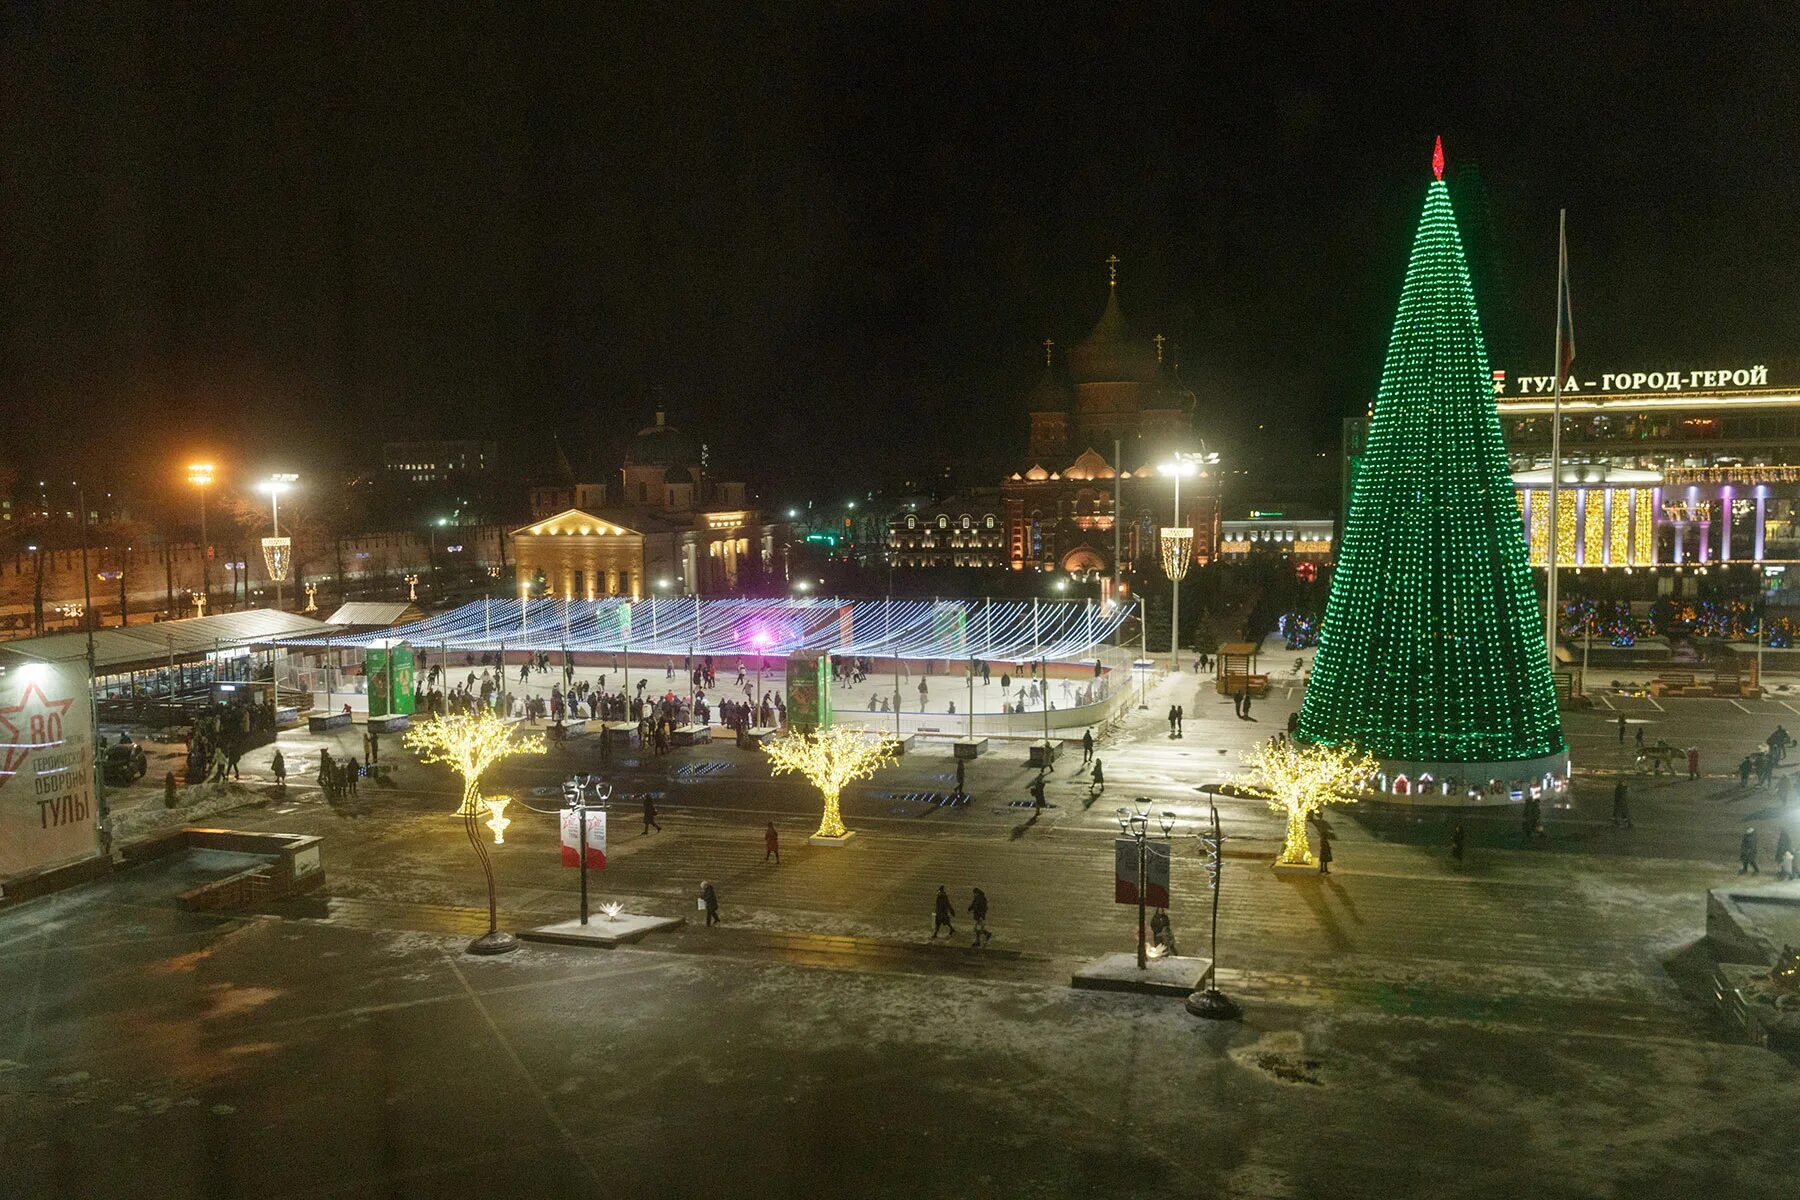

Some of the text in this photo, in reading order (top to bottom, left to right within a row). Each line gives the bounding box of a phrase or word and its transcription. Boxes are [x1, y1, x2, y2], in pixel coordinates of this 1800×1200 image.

[1518, 375, 1580, 393] ТУЛА
[1602, 365, 1768, 391] ГОРОД-ГЕРОЙ
[30, 712, 62, 751] 80
[35, 769, 87, 795] ОБОРОНЫ
[37, 791, 90, 829] ТУЛЫ
